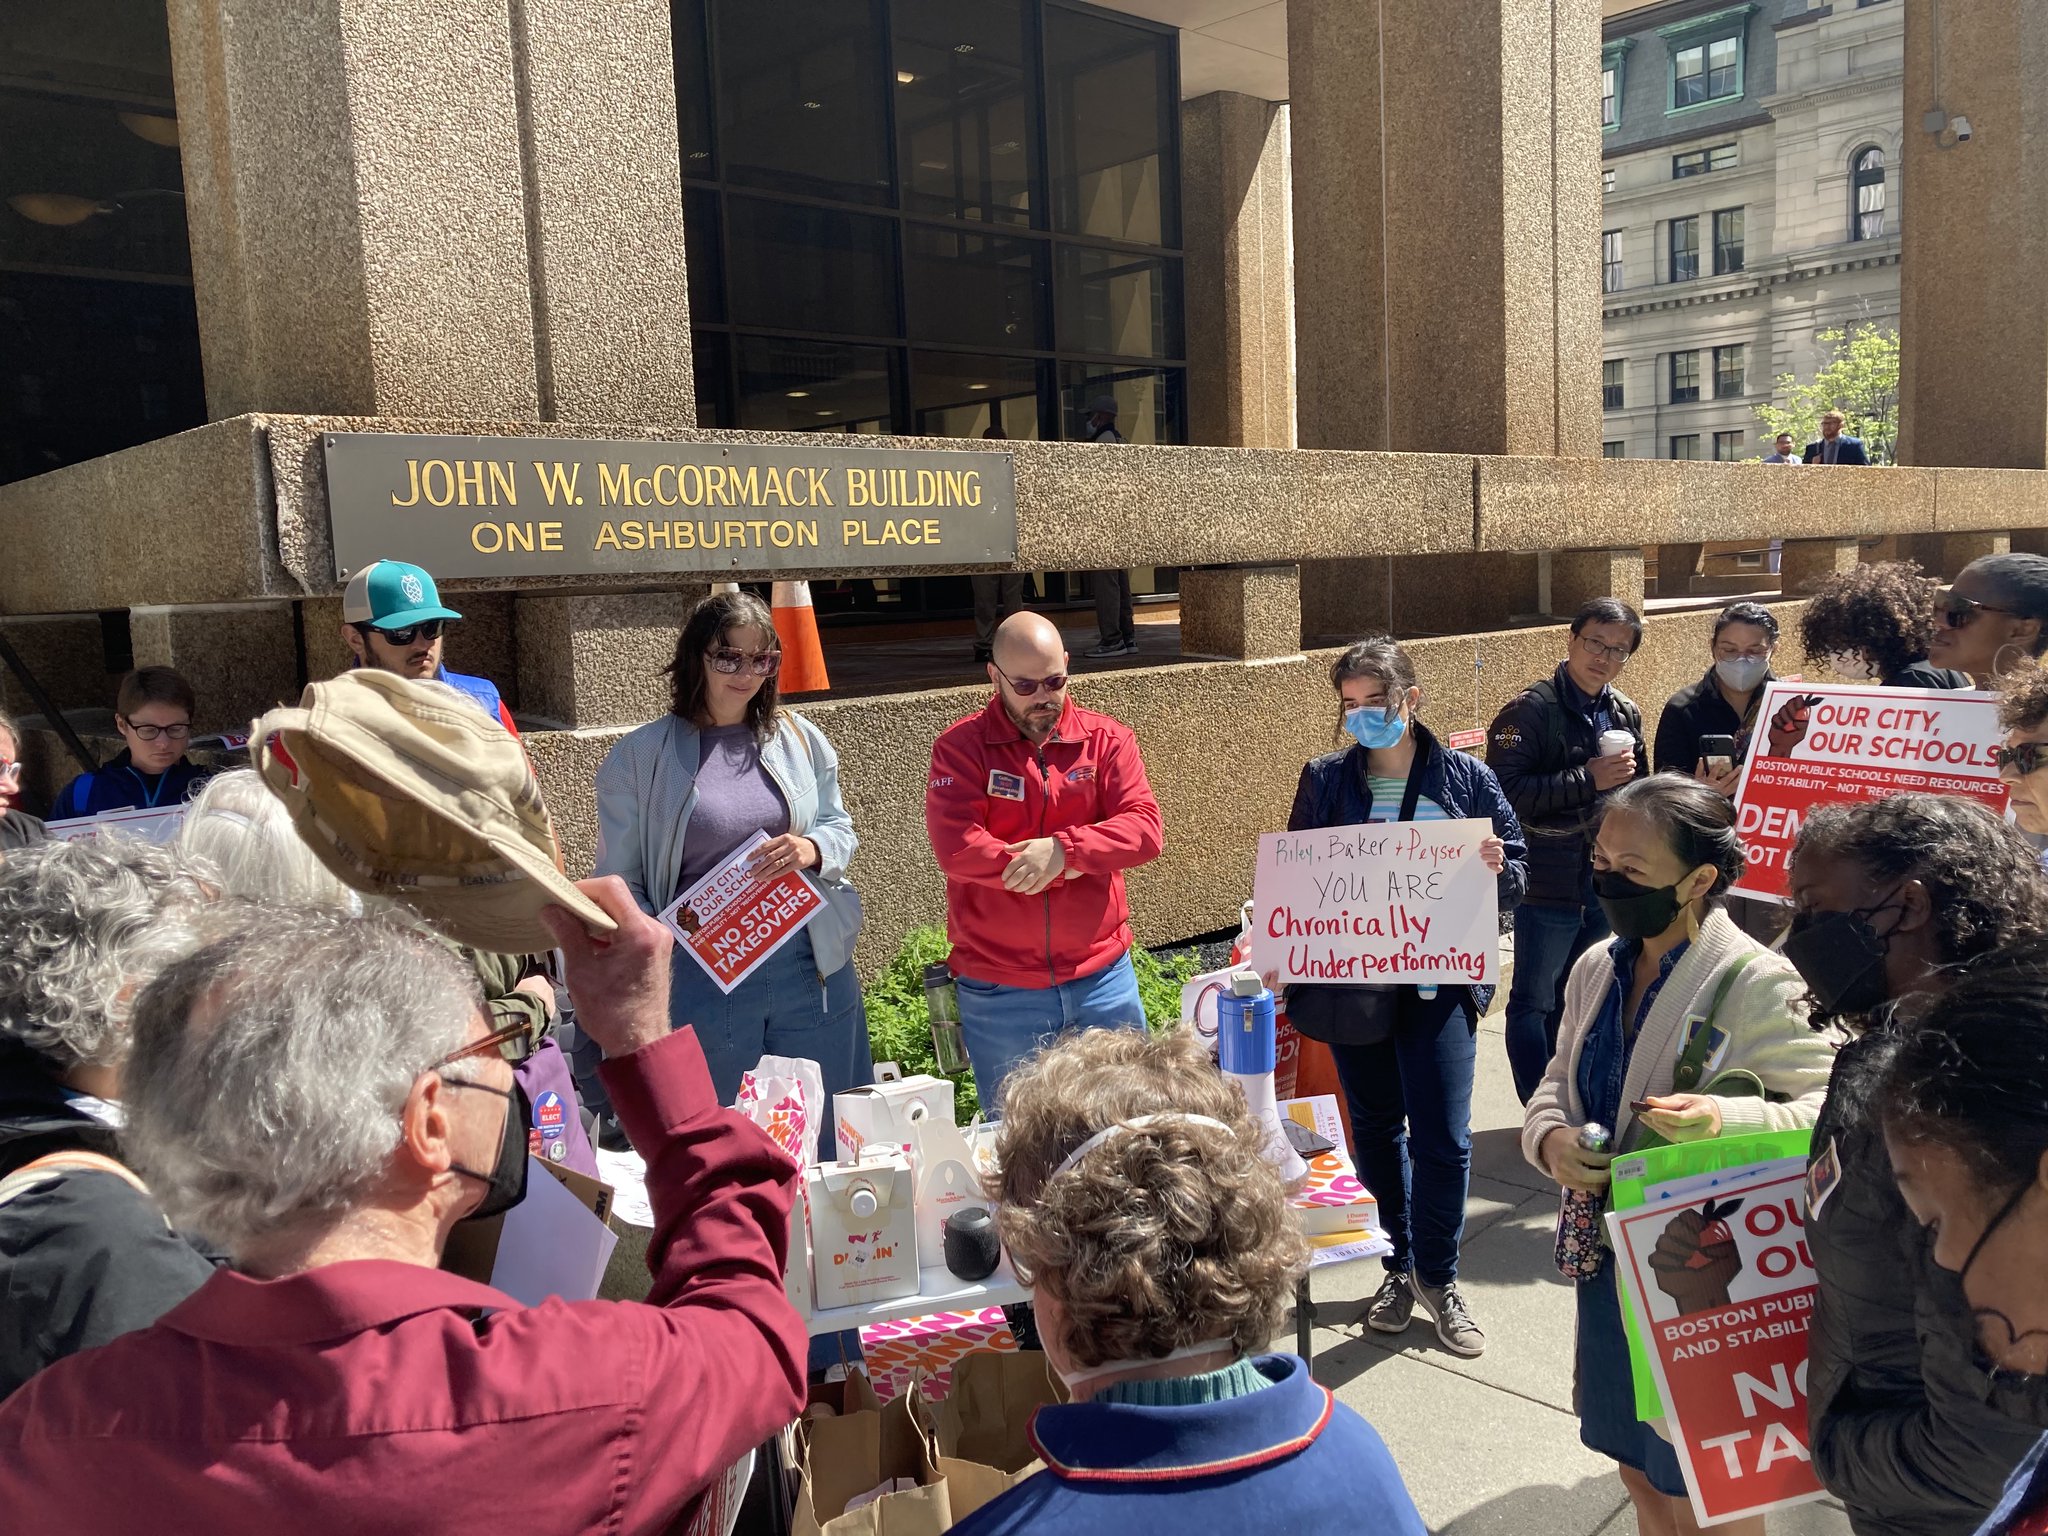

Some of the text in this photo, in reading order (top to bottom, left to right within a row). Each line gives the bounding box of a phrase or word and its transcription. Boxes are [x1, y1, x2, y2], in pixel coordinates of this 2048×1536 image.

[391, 459, 982, 508] JOHN W. McCORMACK BUILDING
[471, 518, 942, 554] ONE ASHBURTON PLACE
[1816, 705, 1941, 736] OUR CITY,
[1809, 732, 2000, 768] OUR SCHOOLS
[1752, 774, 1774, 784] AND
[1756, 760, 1797, 773] BOSTON
[1799, 764, 1836, 777] PUBLIC
[1838, 768, 1890, 782] SCHOOLS
[1894, 774, 1926, 785] NEED
[1928, 777, 2004, 794] RESOURCES
[1328, 833, 1389, 859] Baker
[1407, 828, 1466, 867] Peyser
[693, 886, 717, 907] OUR
[701, 895, 725, 916] OUR
[1313, 871, 1443, 908] YOU ARE
[690, 925, 708, 943] BOSTON
[708, 911, 726, 927] PUBLIC
[725, 894, 747, 913] SCHOOLS
[712, 882, 793, 955] NO STATE
[714, 887, 812, 974] TAKEOVERS
[1268, 904, 1431, 943] Chronically
[542, 1113, 560, 1122] ELECT
[1663, 1306, 1758, 1342] BOSTON
[1672, 1338, 1721, 1362] AND
